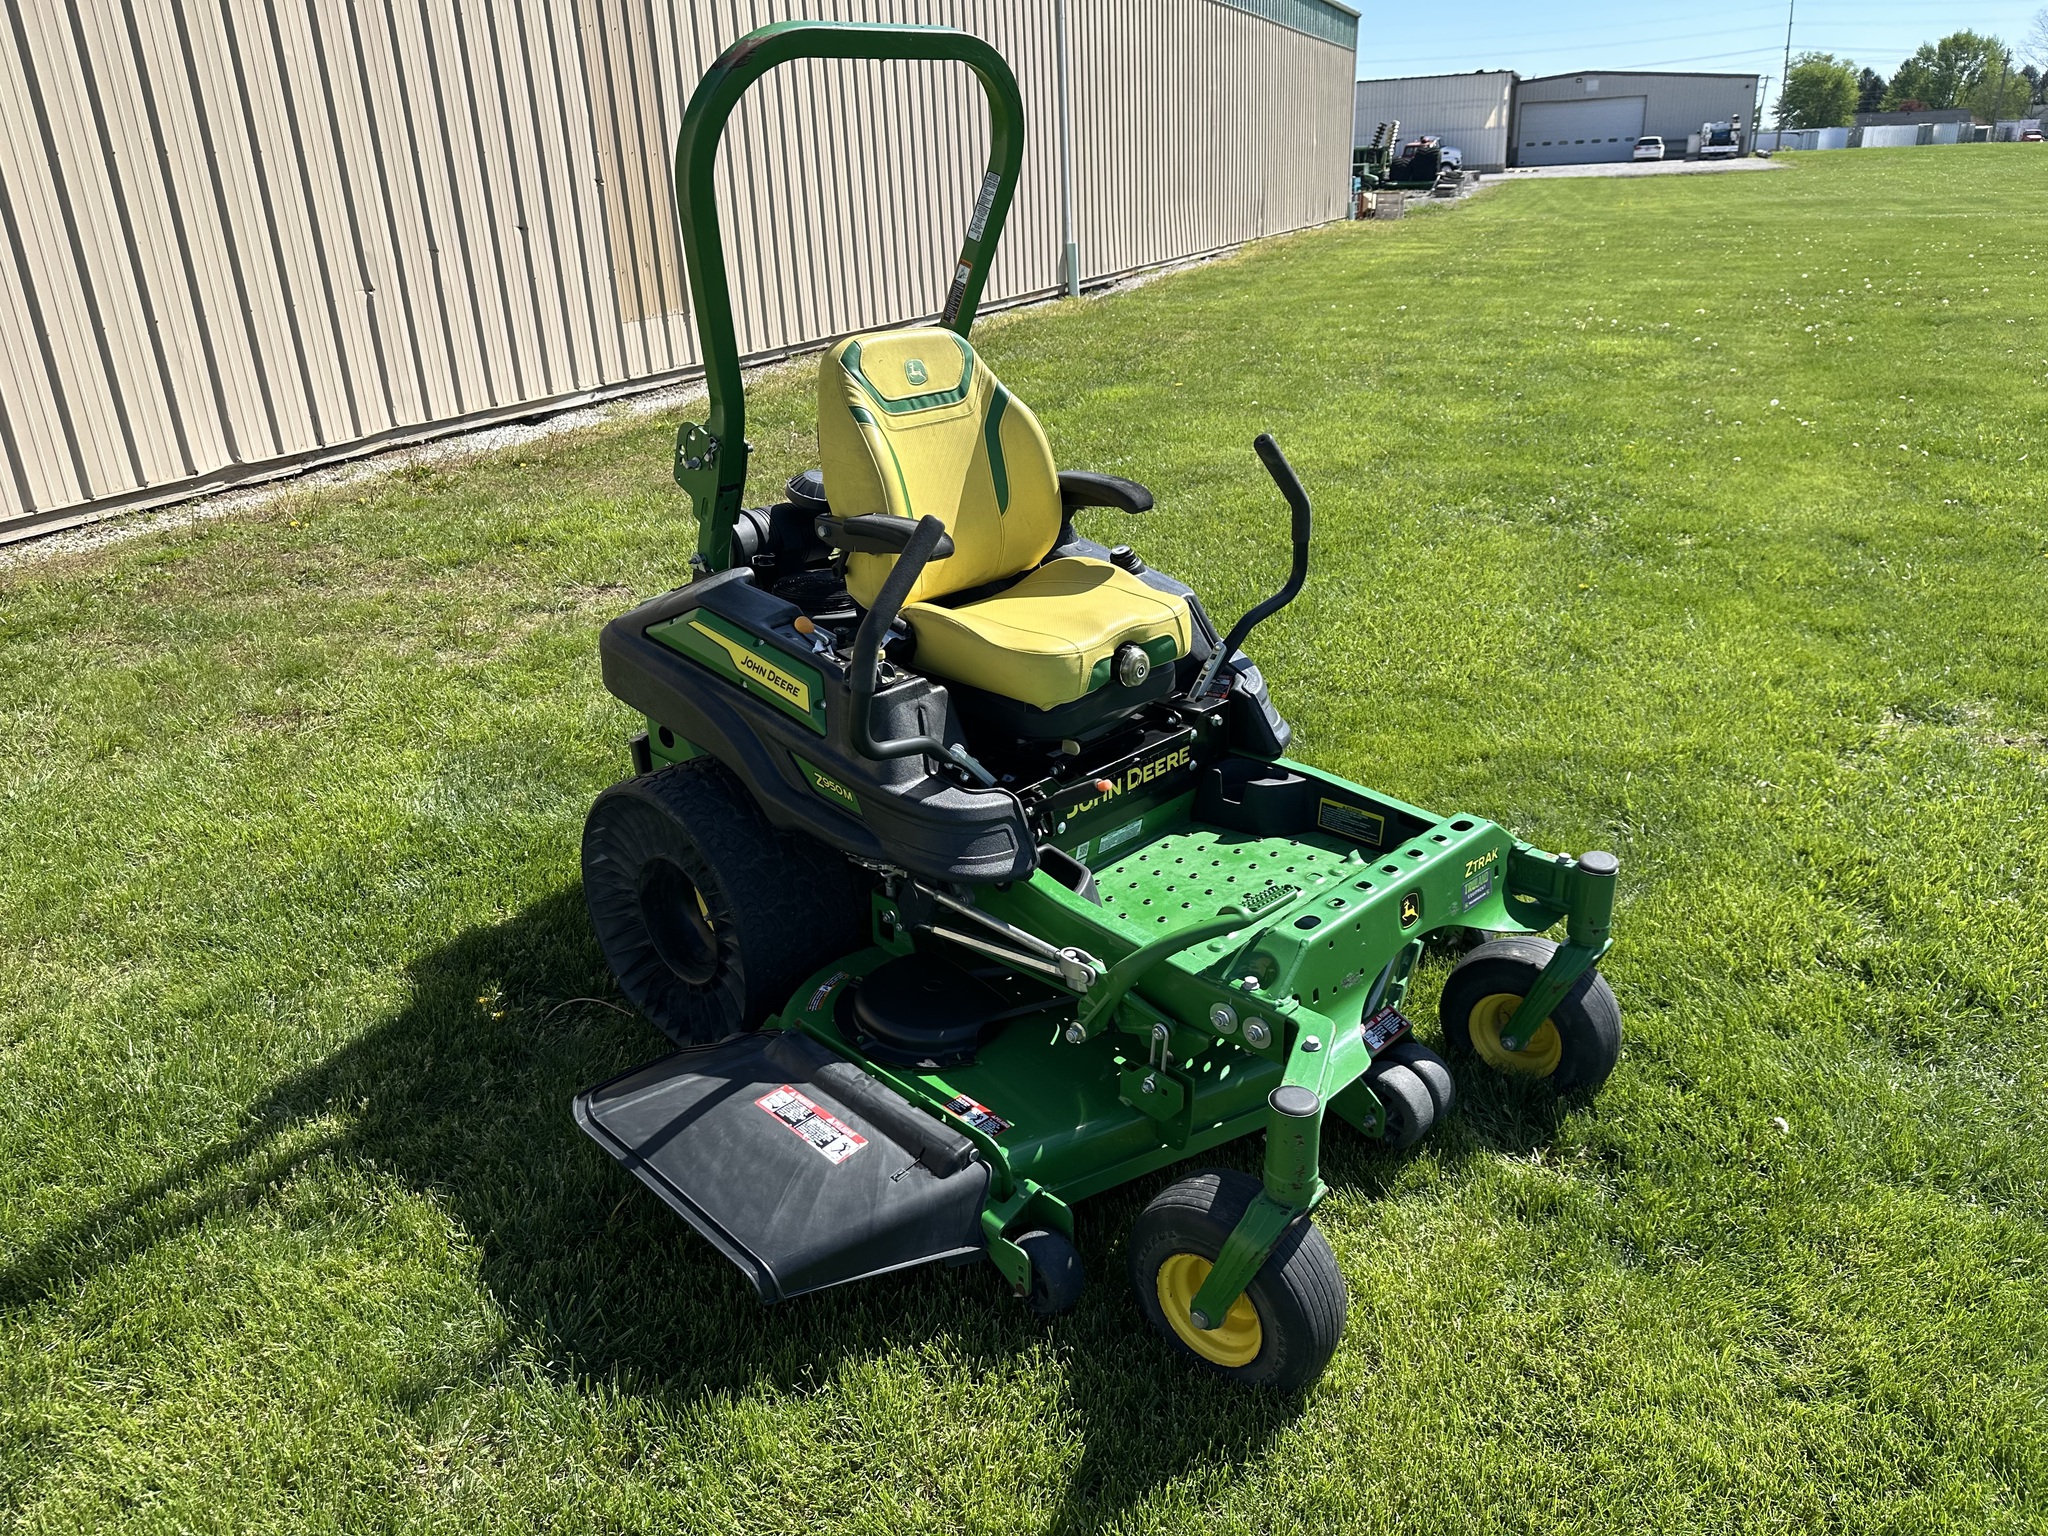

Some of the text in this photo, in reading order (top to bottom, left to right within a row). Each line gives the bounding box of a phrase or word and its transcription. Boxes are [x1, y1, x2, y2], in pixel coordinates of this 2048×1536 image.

[741, 656, 800, 697] JOHN DEERE
[1127, 745, 1190, 791] DEERE
[1464, 847, 1499, 878] ZTRAK
